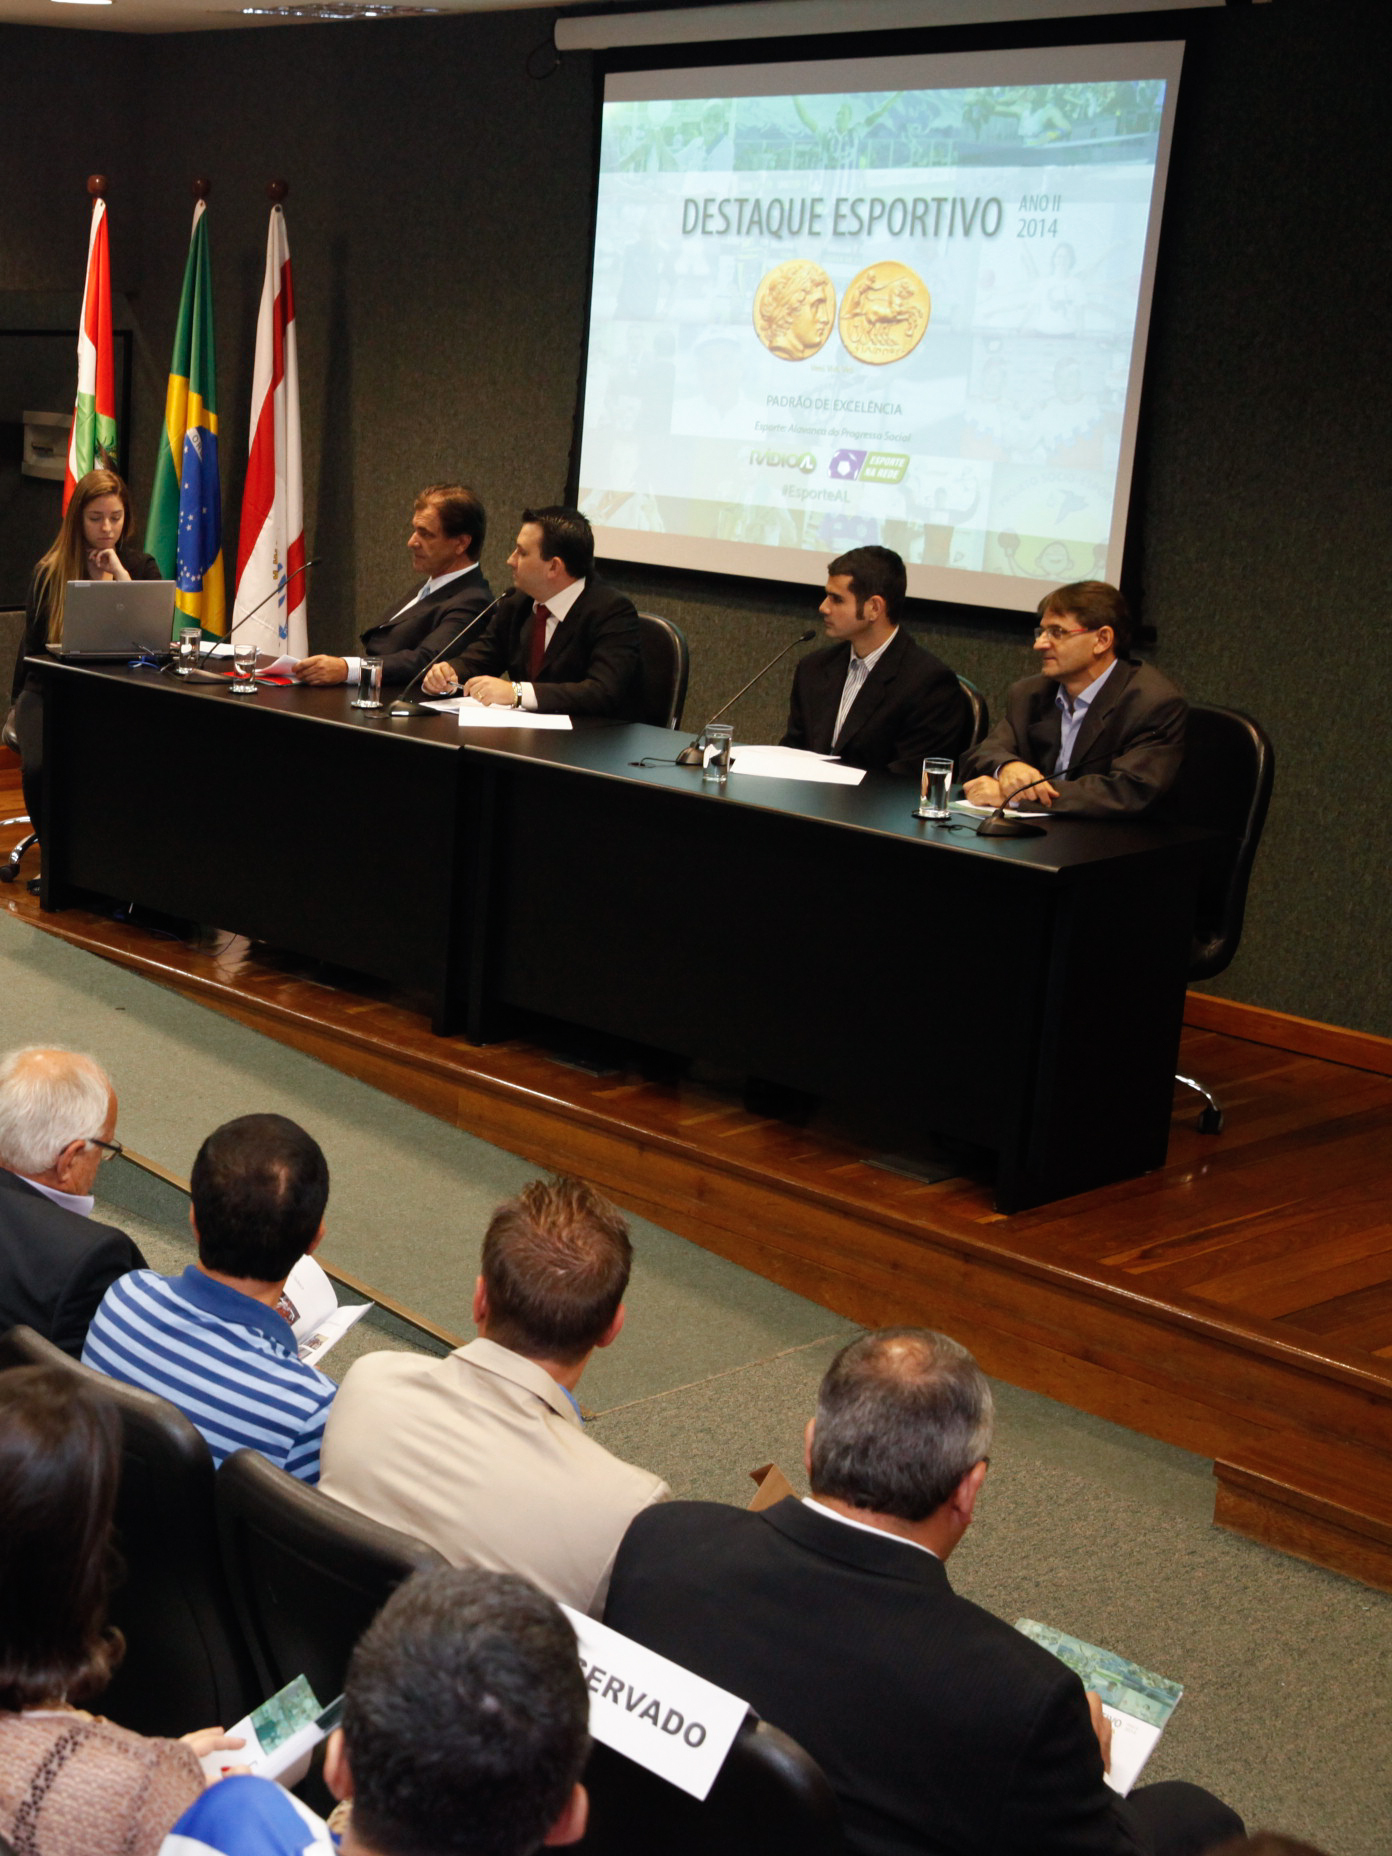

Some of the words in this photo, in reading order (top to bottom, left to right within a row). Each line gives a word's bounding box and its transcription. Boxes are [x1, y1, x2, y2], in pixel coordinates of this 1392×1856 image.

[1018, 195, 1049, 212] ANO
[1051, 194, 1062, 212] II
[681, 197, 824, 239] DESTAQUE
[832, 196, 1004, 237] ESPORTIVO
[1016, 218, 1059, 238] 2014
[766, 394, 813, 409] PADRÃO
[814, 398, 830, 410] DE
[883, 431, 912, 442] Social
[869, 454, 906, 467] ESPORTE
[782, 484, 851, 503] #EsporteAL
[578, 1656, 707, 1748] ERVADO
